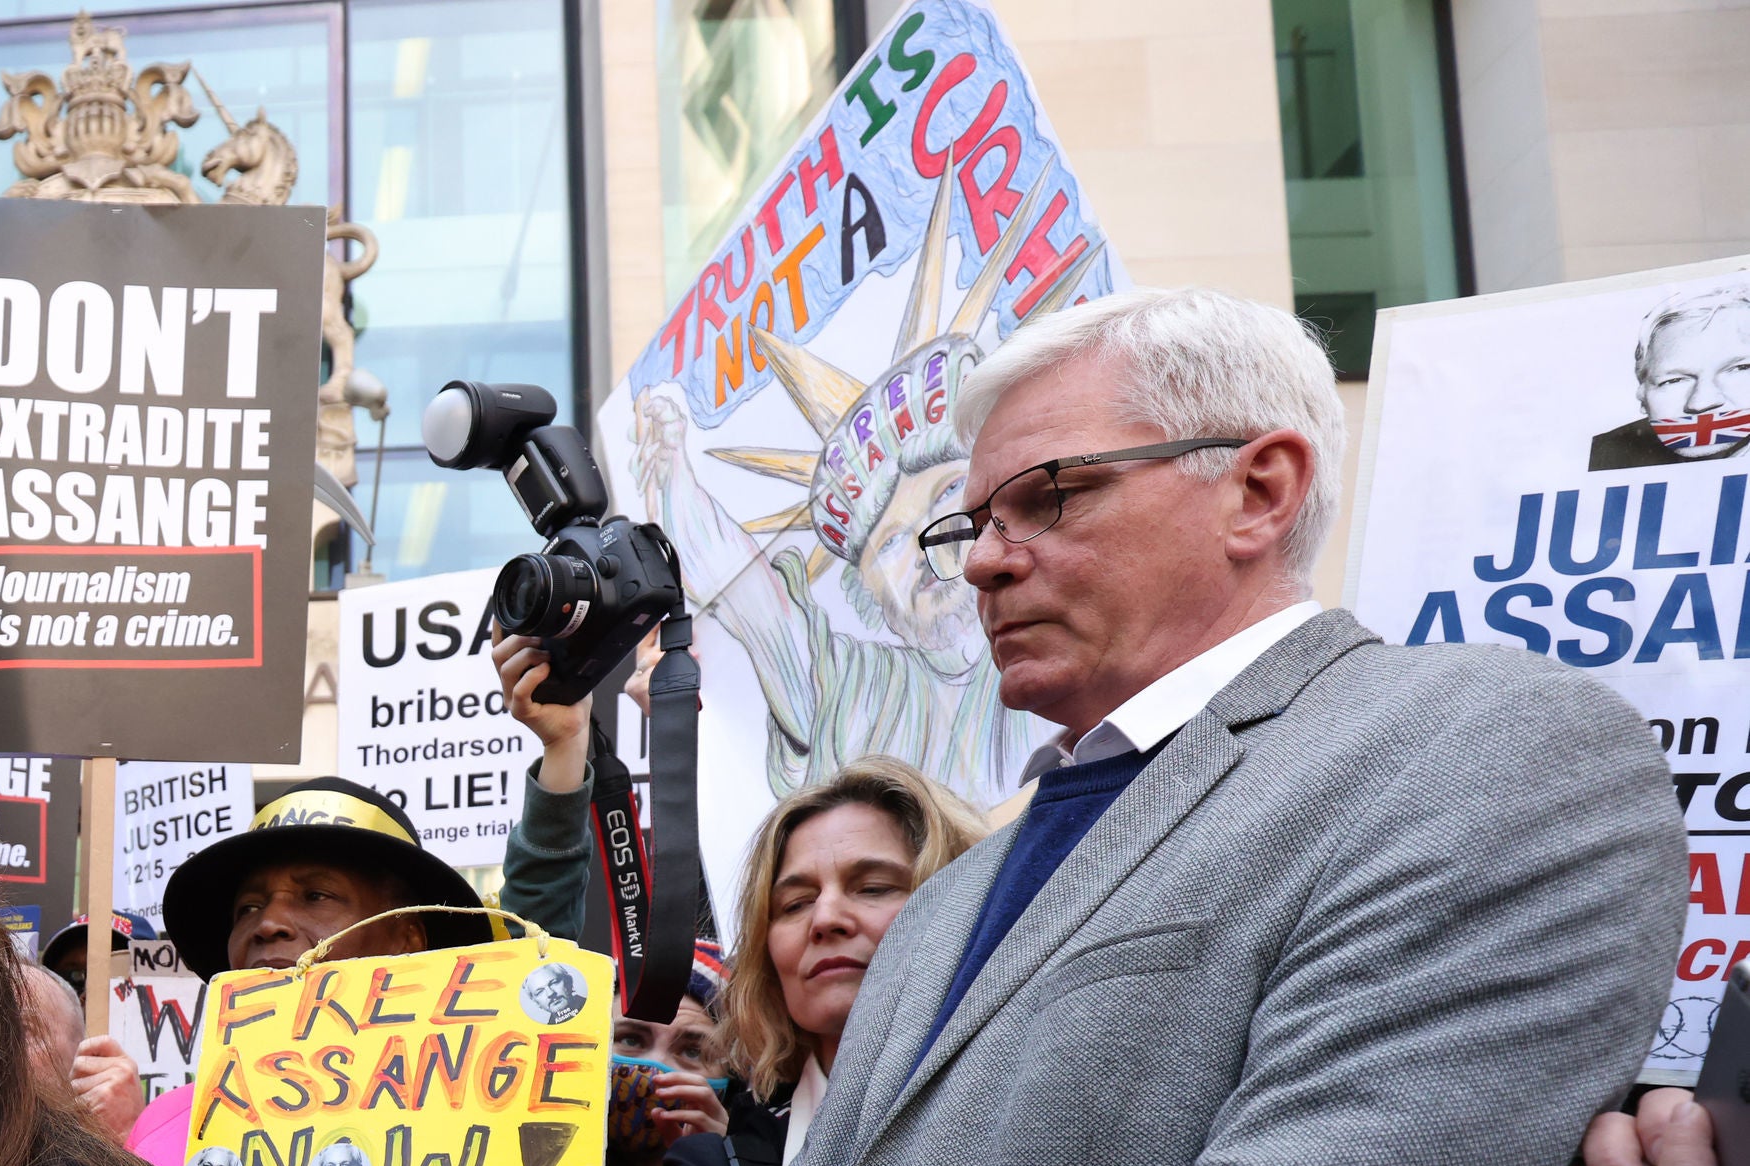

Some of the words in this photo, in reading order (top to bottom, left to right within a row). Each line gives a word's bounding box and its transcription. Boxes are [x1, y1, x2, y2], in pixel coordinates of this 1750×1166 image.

[659, 124, 844, 379] TRUTH
[844, 11, 936, 149] IS
[912, 52, 1090, 320] CRI
[715, 222, 826, 409] NOT
[840, 172, 888, 286] A
[1473, 474, 1750, 582] JULI
[26, 610, 90, 646] not
[94, 617, 118, 646] a
[124, 609, 239, 648] crime.
[1405, 569, 1750, 668] ASSA
[357, 734, 523, 768] Thordarson
[124, 765, 227, 816] BRITISH
[425, 770, 509, 811] LIE!
[123, 805, 233, 855] JUSTICE
[476, 819, 514, 837] trial
[607, 810, 634, 867] EOS
[124, 859, 164, 886] 1215
[618, 871, 641, 900] 5D
[624, 905, 641, 943] Mark
[630, 940, 643, 958] IV
[216, 950, 519, 1045] FREE
[557, 1007, 571, 1017] Free
[194, 1024, 599, 1141] ASSANGE
